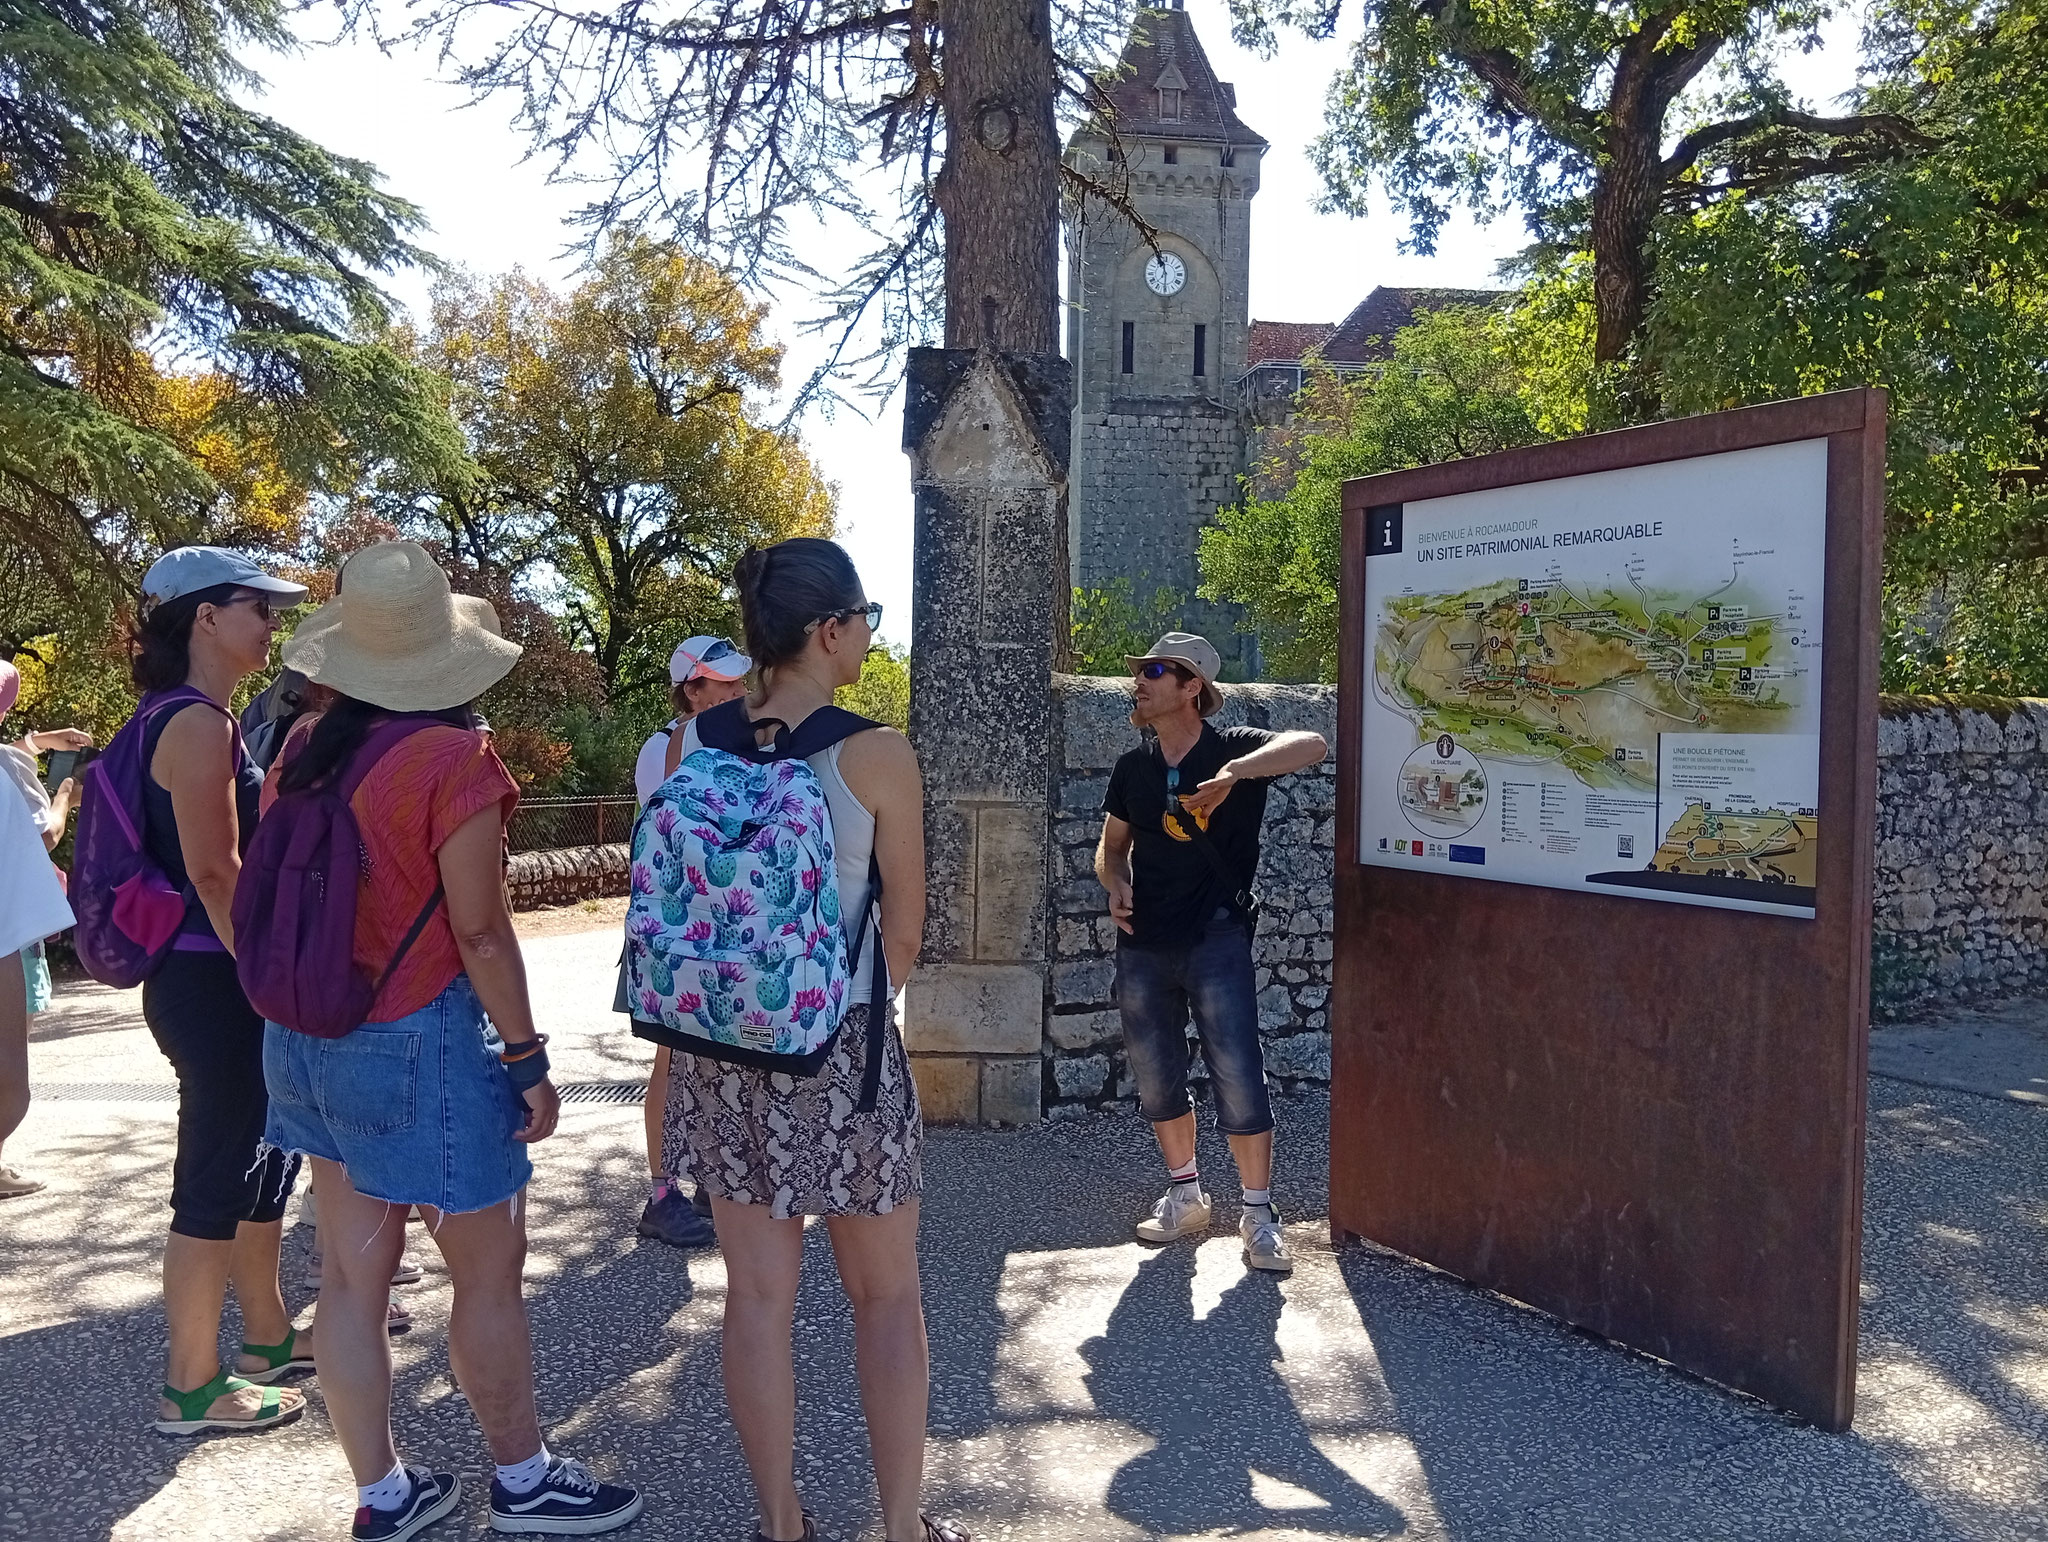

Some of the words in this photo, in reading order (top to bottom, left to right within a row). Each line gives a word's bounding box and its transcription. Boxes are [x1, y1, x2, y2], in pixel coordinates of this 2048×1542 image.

[1384, 520, 1392, 546] i
[1417, 548, 1434, 562] UN
[1436, 546, 1462, 560] SITE
[1466, 535, 1549, 557] PATRIMONIAL
[1553, 521, 1663, 548] REMARQUABLE
[1418, 528, 1465, 544] BIENVENUE
[1467, 528, 1474, 538] À
[1475, 519, 1538, 536] ROCAMADOUR
[1394, 839, 1407, 851] LOT
